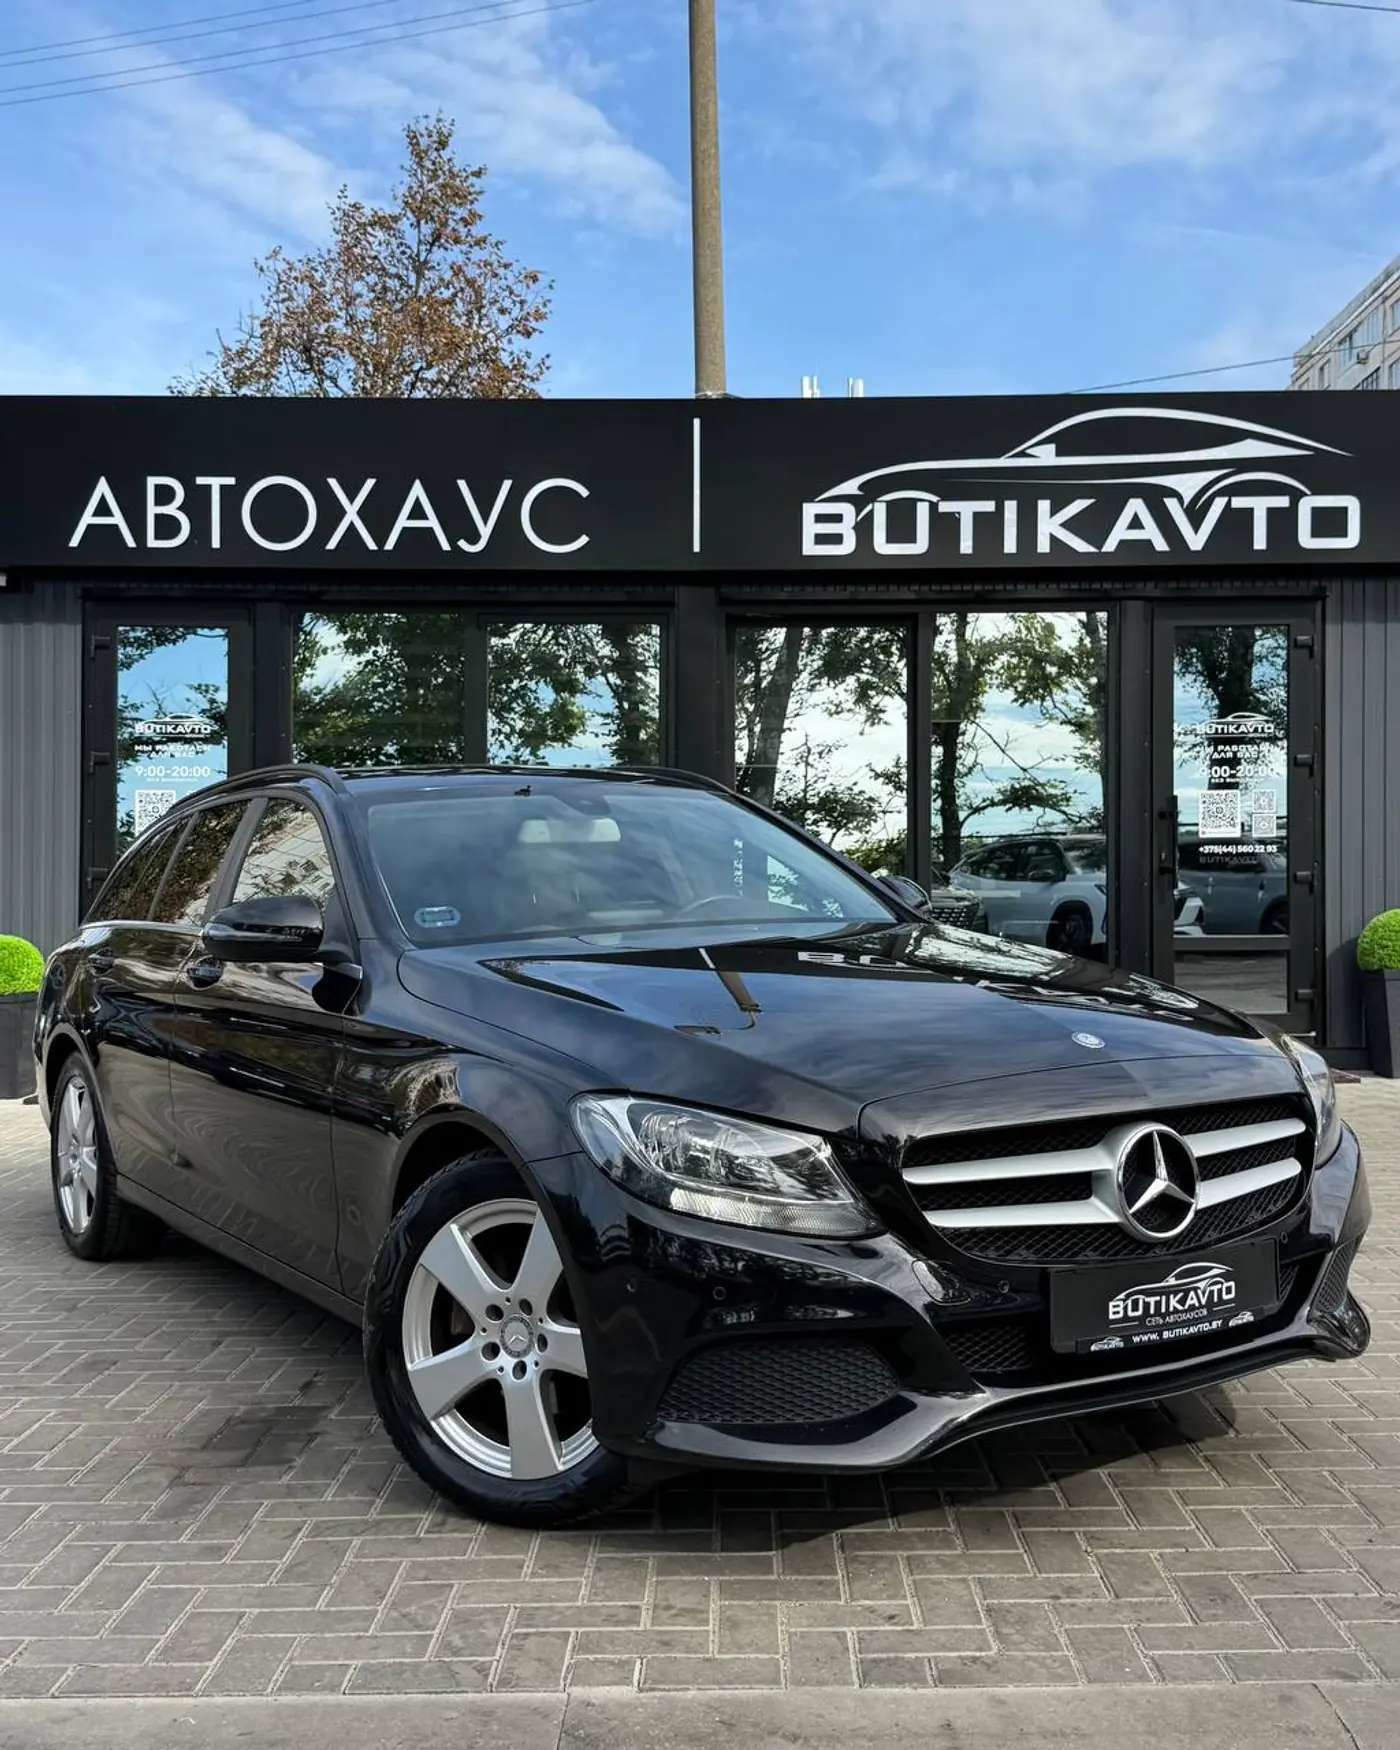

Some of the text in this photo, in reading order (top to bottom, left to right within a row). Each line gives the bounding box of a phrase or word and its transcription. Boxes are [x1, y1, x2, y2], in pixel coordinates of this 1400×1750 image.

[68, 475, 590, 554] АВТОХАУС
[802, 494, 1362, 556] BUTIKAVTO
[135, 723, 212, 734] BUTIKAVTO
[135, 765, 211, 777] 9:00-20:00
[1109, 1281, 1236, 1320] BUTIKAVTO
